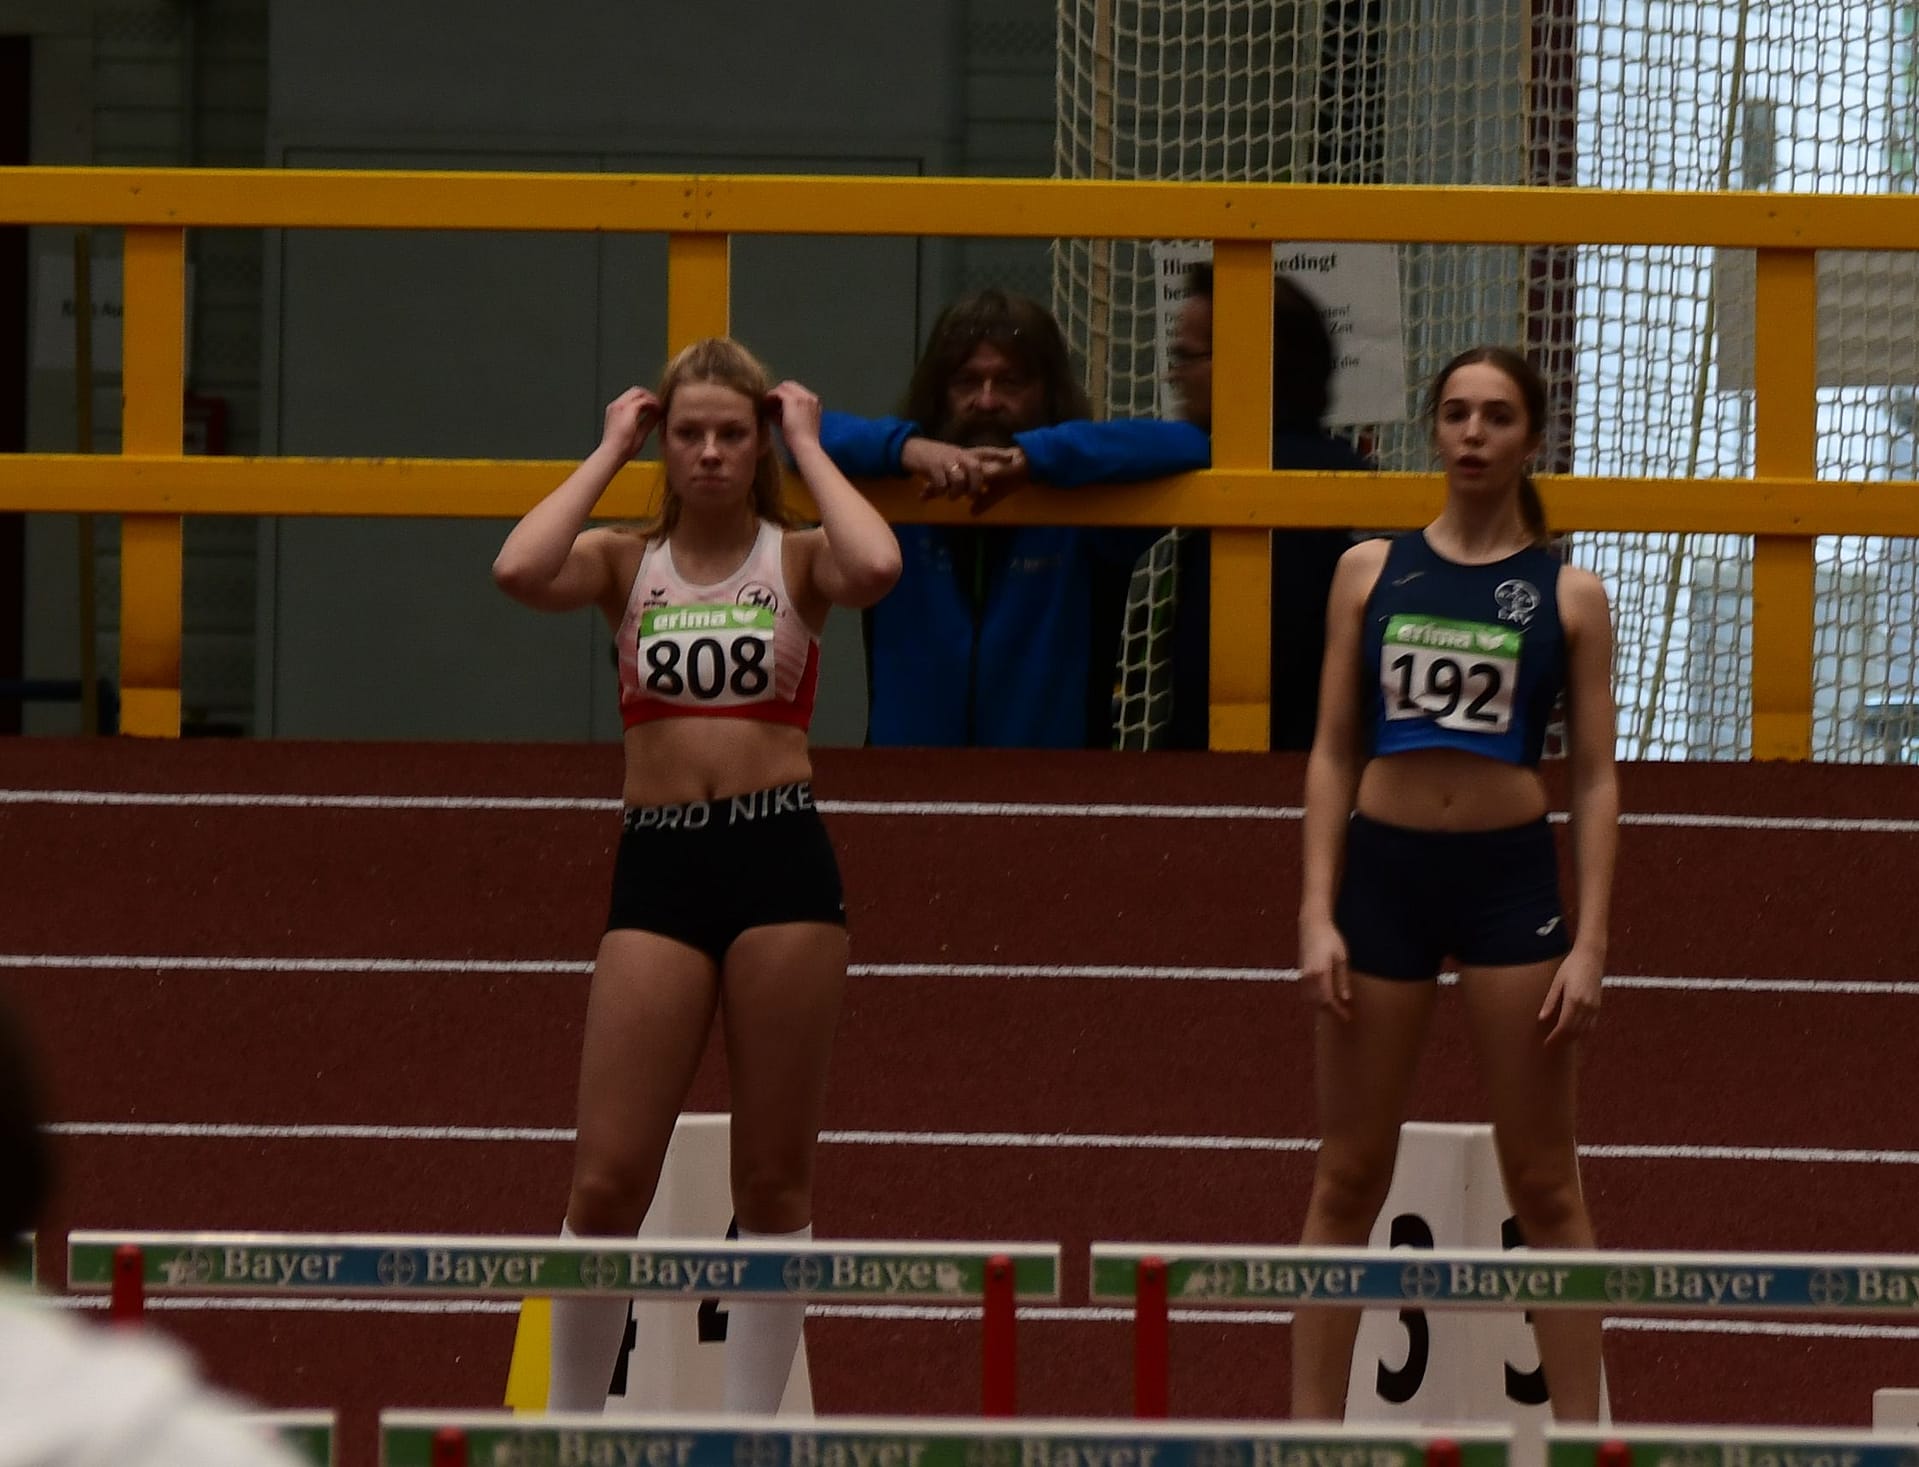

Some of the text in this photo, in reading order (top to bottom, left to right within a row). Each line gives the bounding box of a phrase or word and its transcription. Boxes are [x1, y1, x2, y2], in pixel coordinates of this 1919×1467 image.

[653, 608, 727, 632] erima
[646, 637, 768, 699] 808
[1391, 653, 1501, 723] 192
[634, 800, 711, 832] PRO
[728, 782, 815, 827] NIKE
[223, 1248, 343, 1286] Bayer
[426, 1250, 546, 1289] Bayer
[629, 1252, 749, 1292] Bayer
[1246, 1260, 1367, 1299] Bayer
[1449, 1262, 1570, 1301] Bayer
[1653, 1265, 1775, 1304] Bayer
